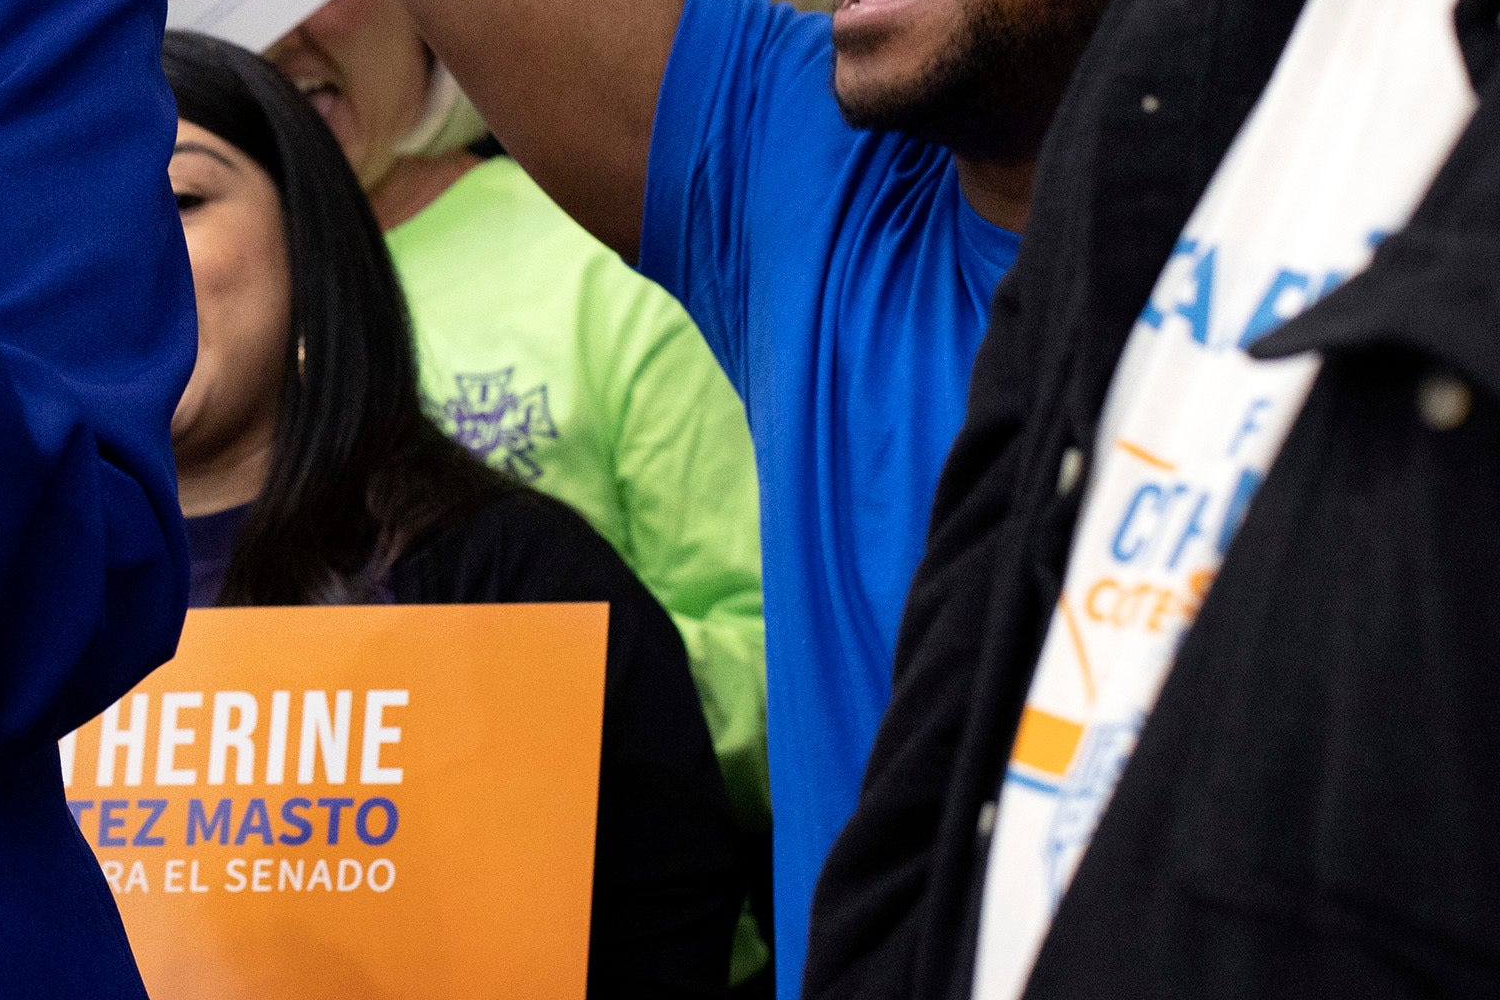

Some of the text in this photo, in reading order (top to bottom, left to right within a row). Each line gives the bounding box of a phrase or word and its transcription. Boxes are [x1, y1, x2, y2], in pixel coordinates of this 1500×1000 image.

[186, 797, 399, 847] MASTO
[164, 859, 209, 893] EL
[225, 858, 396, 893] SENADO
